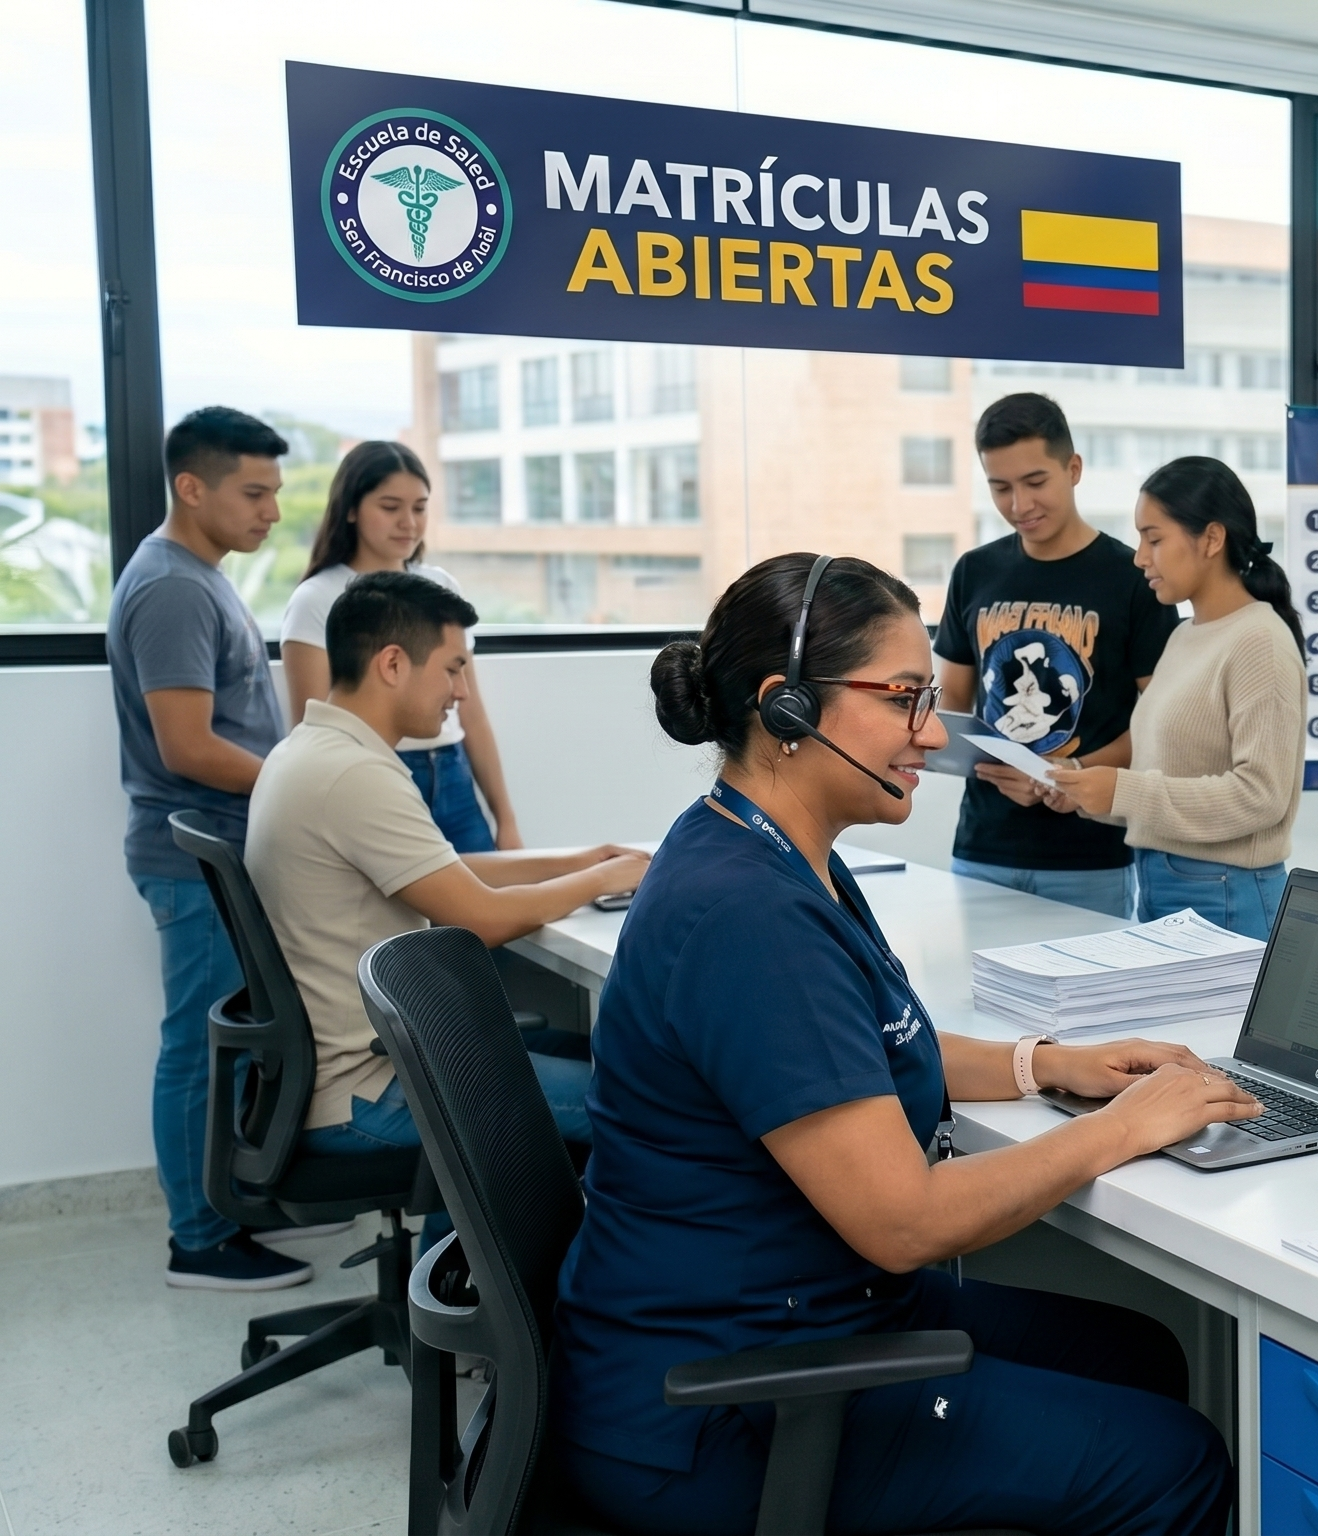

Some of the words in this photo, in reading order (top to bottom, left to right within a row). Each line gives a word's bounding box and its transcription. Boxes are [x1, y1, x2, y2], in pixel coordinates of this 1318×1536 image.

[338, 123, 409, 181] Escuela
[415, 122, 441, 145] de
[444, 135, 496, 191] Saled
[543, 147, 990, 246] MATRÍCULAS
[339, 218, 366, 254] Sen
[364, 251, 450, 287] Francisco
[452, 259, 474, 280] de
[566, 228, 956, 317] ABIERTAS
